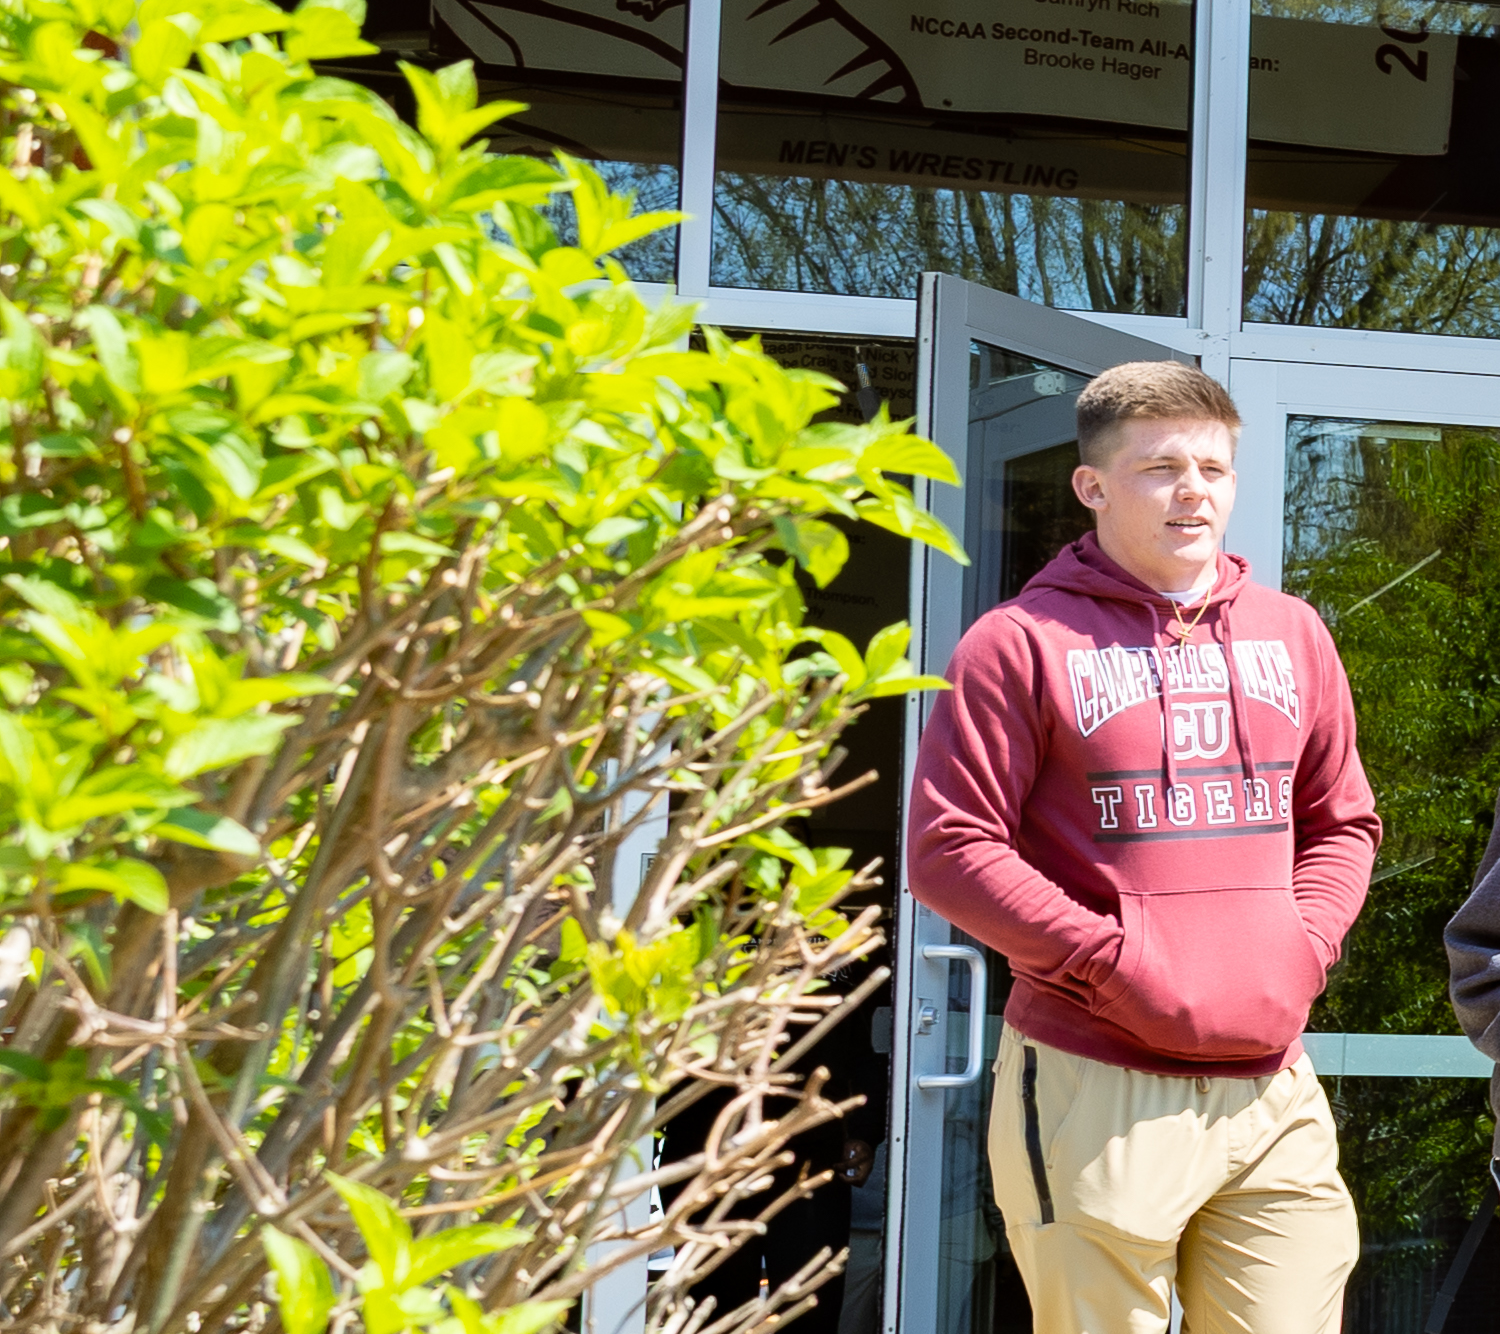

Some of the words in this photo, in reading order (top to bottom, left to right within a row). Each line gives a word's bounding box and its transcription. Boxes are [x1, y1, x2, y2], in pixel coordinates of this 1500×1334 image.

[910, 14, 987, 40] NCCAA
[991, 22, 1135, 53] Second-Team
[1024, 47, 1095, 71] Brooke
[1101, 55, 1162, 81] Hager
[778, 139, 878, 169] MEN'S
[888, 148, 1080, 192] WRESTLING
[1161, 700, 1232, 761] CU
[1091, 776, 1294, 830] TIGERS
